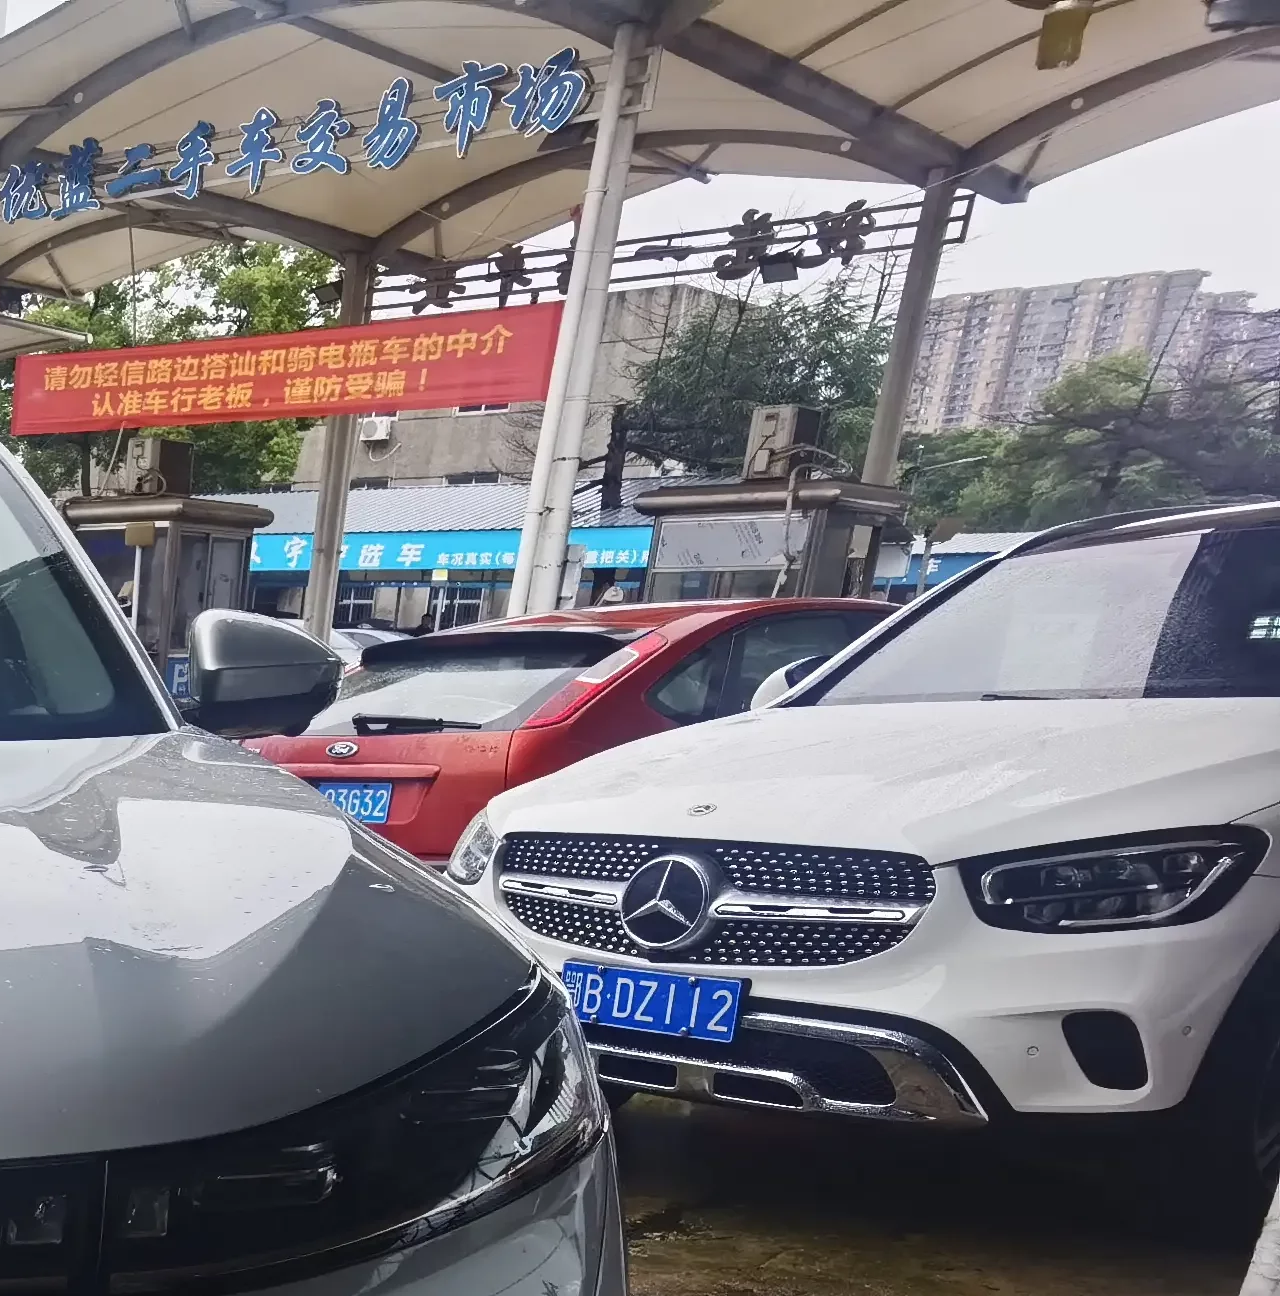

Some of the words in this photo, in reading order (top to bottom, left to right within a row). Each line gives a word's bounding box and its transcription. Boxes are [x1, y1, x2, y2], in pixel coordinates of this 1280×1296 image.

[43, 322, 513, 392] 请勿轻信路边搭讪和骑电瓶车的中介
